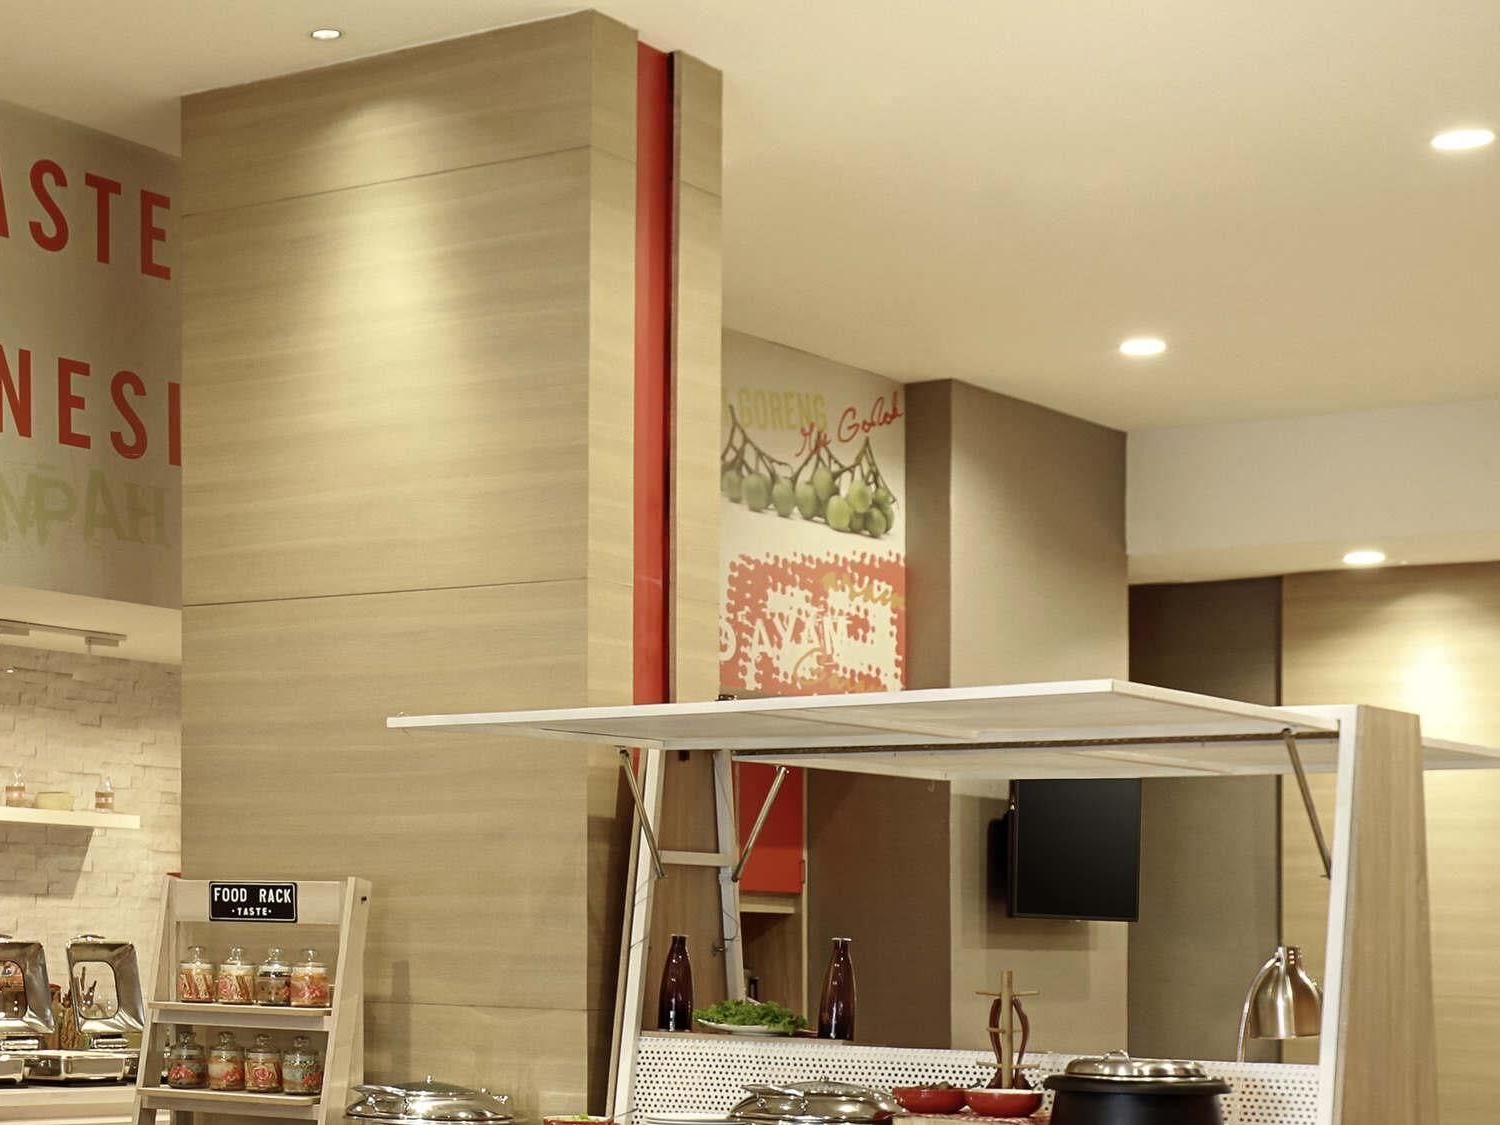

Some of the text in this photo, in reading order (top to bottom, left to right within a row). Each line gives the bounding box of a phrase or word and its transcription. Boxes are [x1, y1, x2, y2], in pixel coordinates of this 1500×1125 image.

[213, 887, 292, 904] FOOD RACK
[237, 907, 268, 916] TASTE
